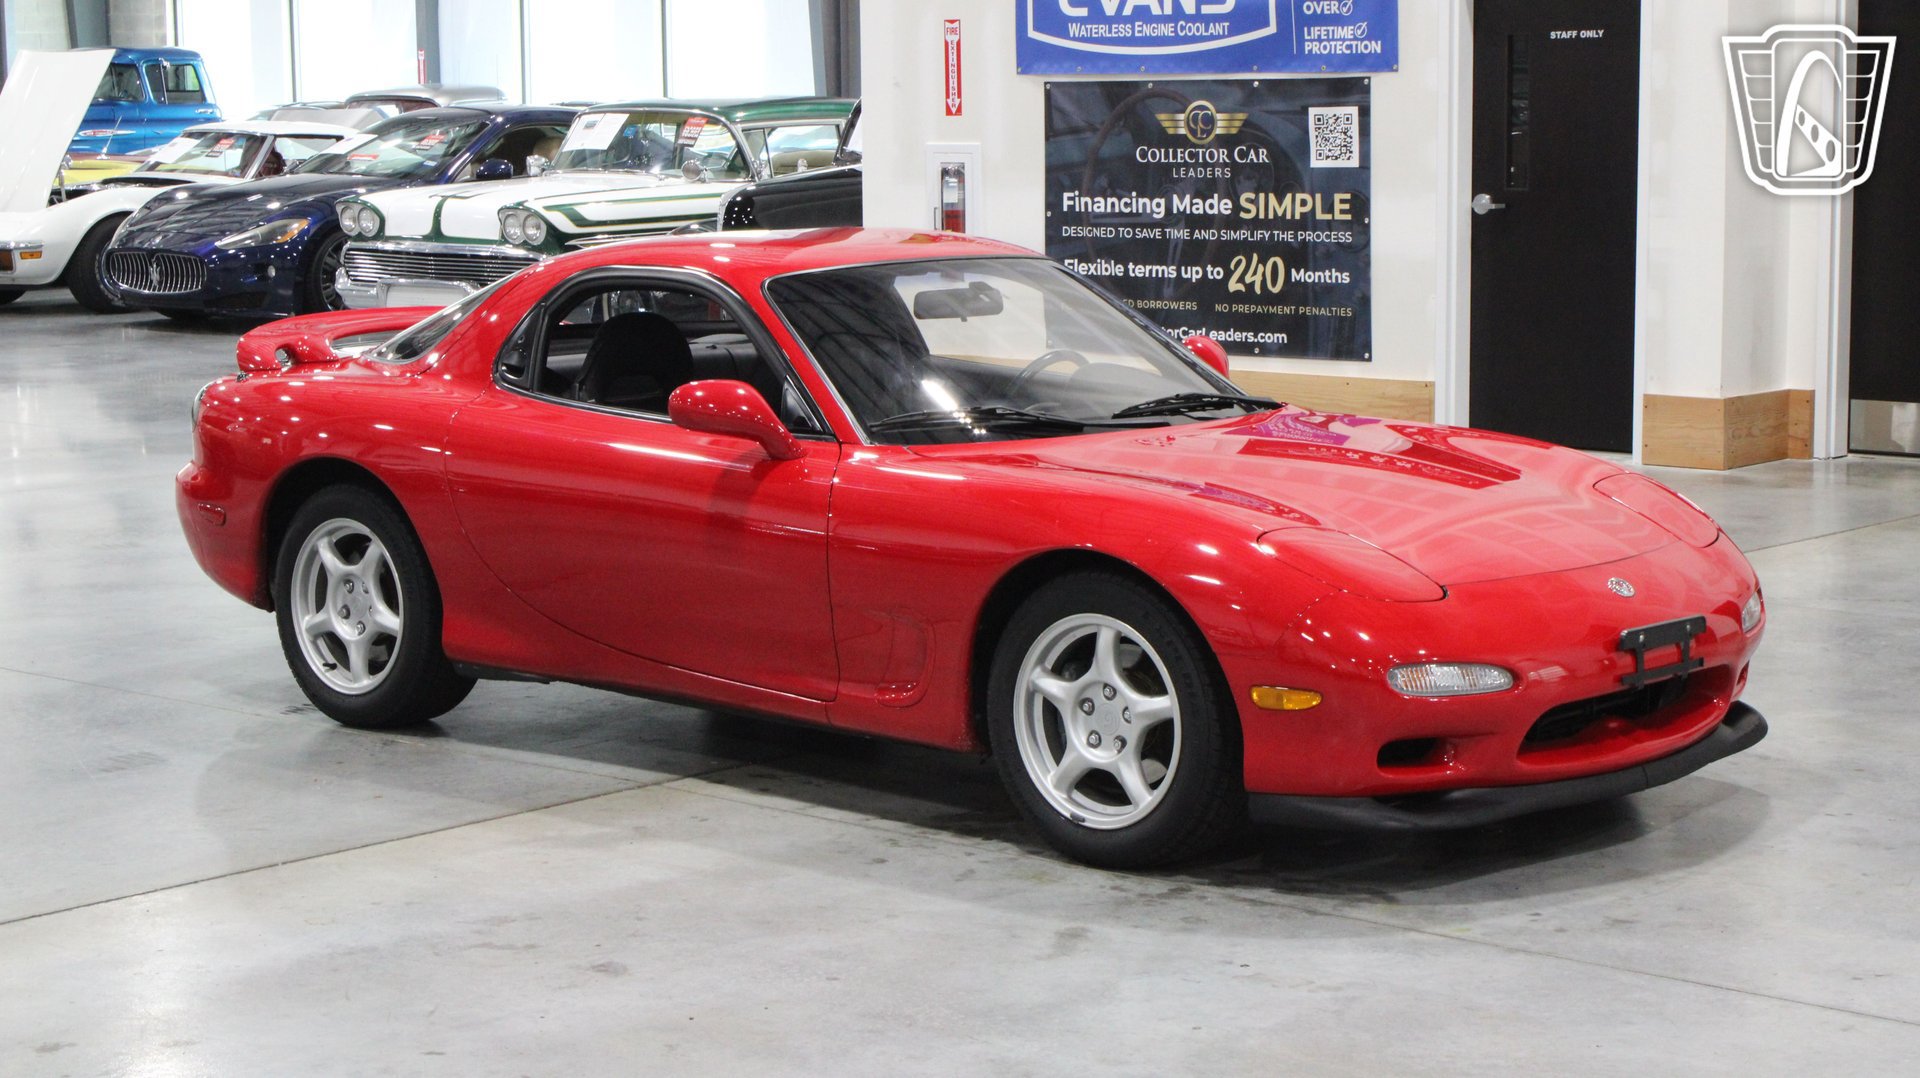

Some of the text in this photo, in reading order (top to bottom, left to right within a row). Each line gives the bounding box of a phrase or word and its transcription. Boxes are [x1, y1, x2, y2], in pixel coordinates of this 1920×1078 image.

[1302, 1, 1340, 15] OVER
[946, 27, 958, 35] FIRE
[1068, 20, 1229, 38] WATERLESS ENGINE COOLANT
[1304, 26, 1354, 39] LIFETIME
[1550, 29, 1604, 39] STAFF ONLY
[1304, 41, 1382, 54] PROTECTION
[1136, 146, 1269, 163] COLLECTOR CAR
[1172, 168, 1232, 178] LEADERS
[1062, 191, 1352, 221] Financing Made SIMPLE
[1062, 226, 1352, 243] DESIGNED TO SAVE TIME AND SIMPLIFY THE PROCESS
[1064, 252, 1350, 295] Flexible terms up to 240 Months
[1137, 300, 1198, 311] BORROWERS
[1215, 303, 1229, 313] NO
[1232, 304, 1296, 315] PREPAYMENT
[1299, 306, 1352, 317] PENALTIES
[1162, 327, 1288, 344] orCarLeaders.com
